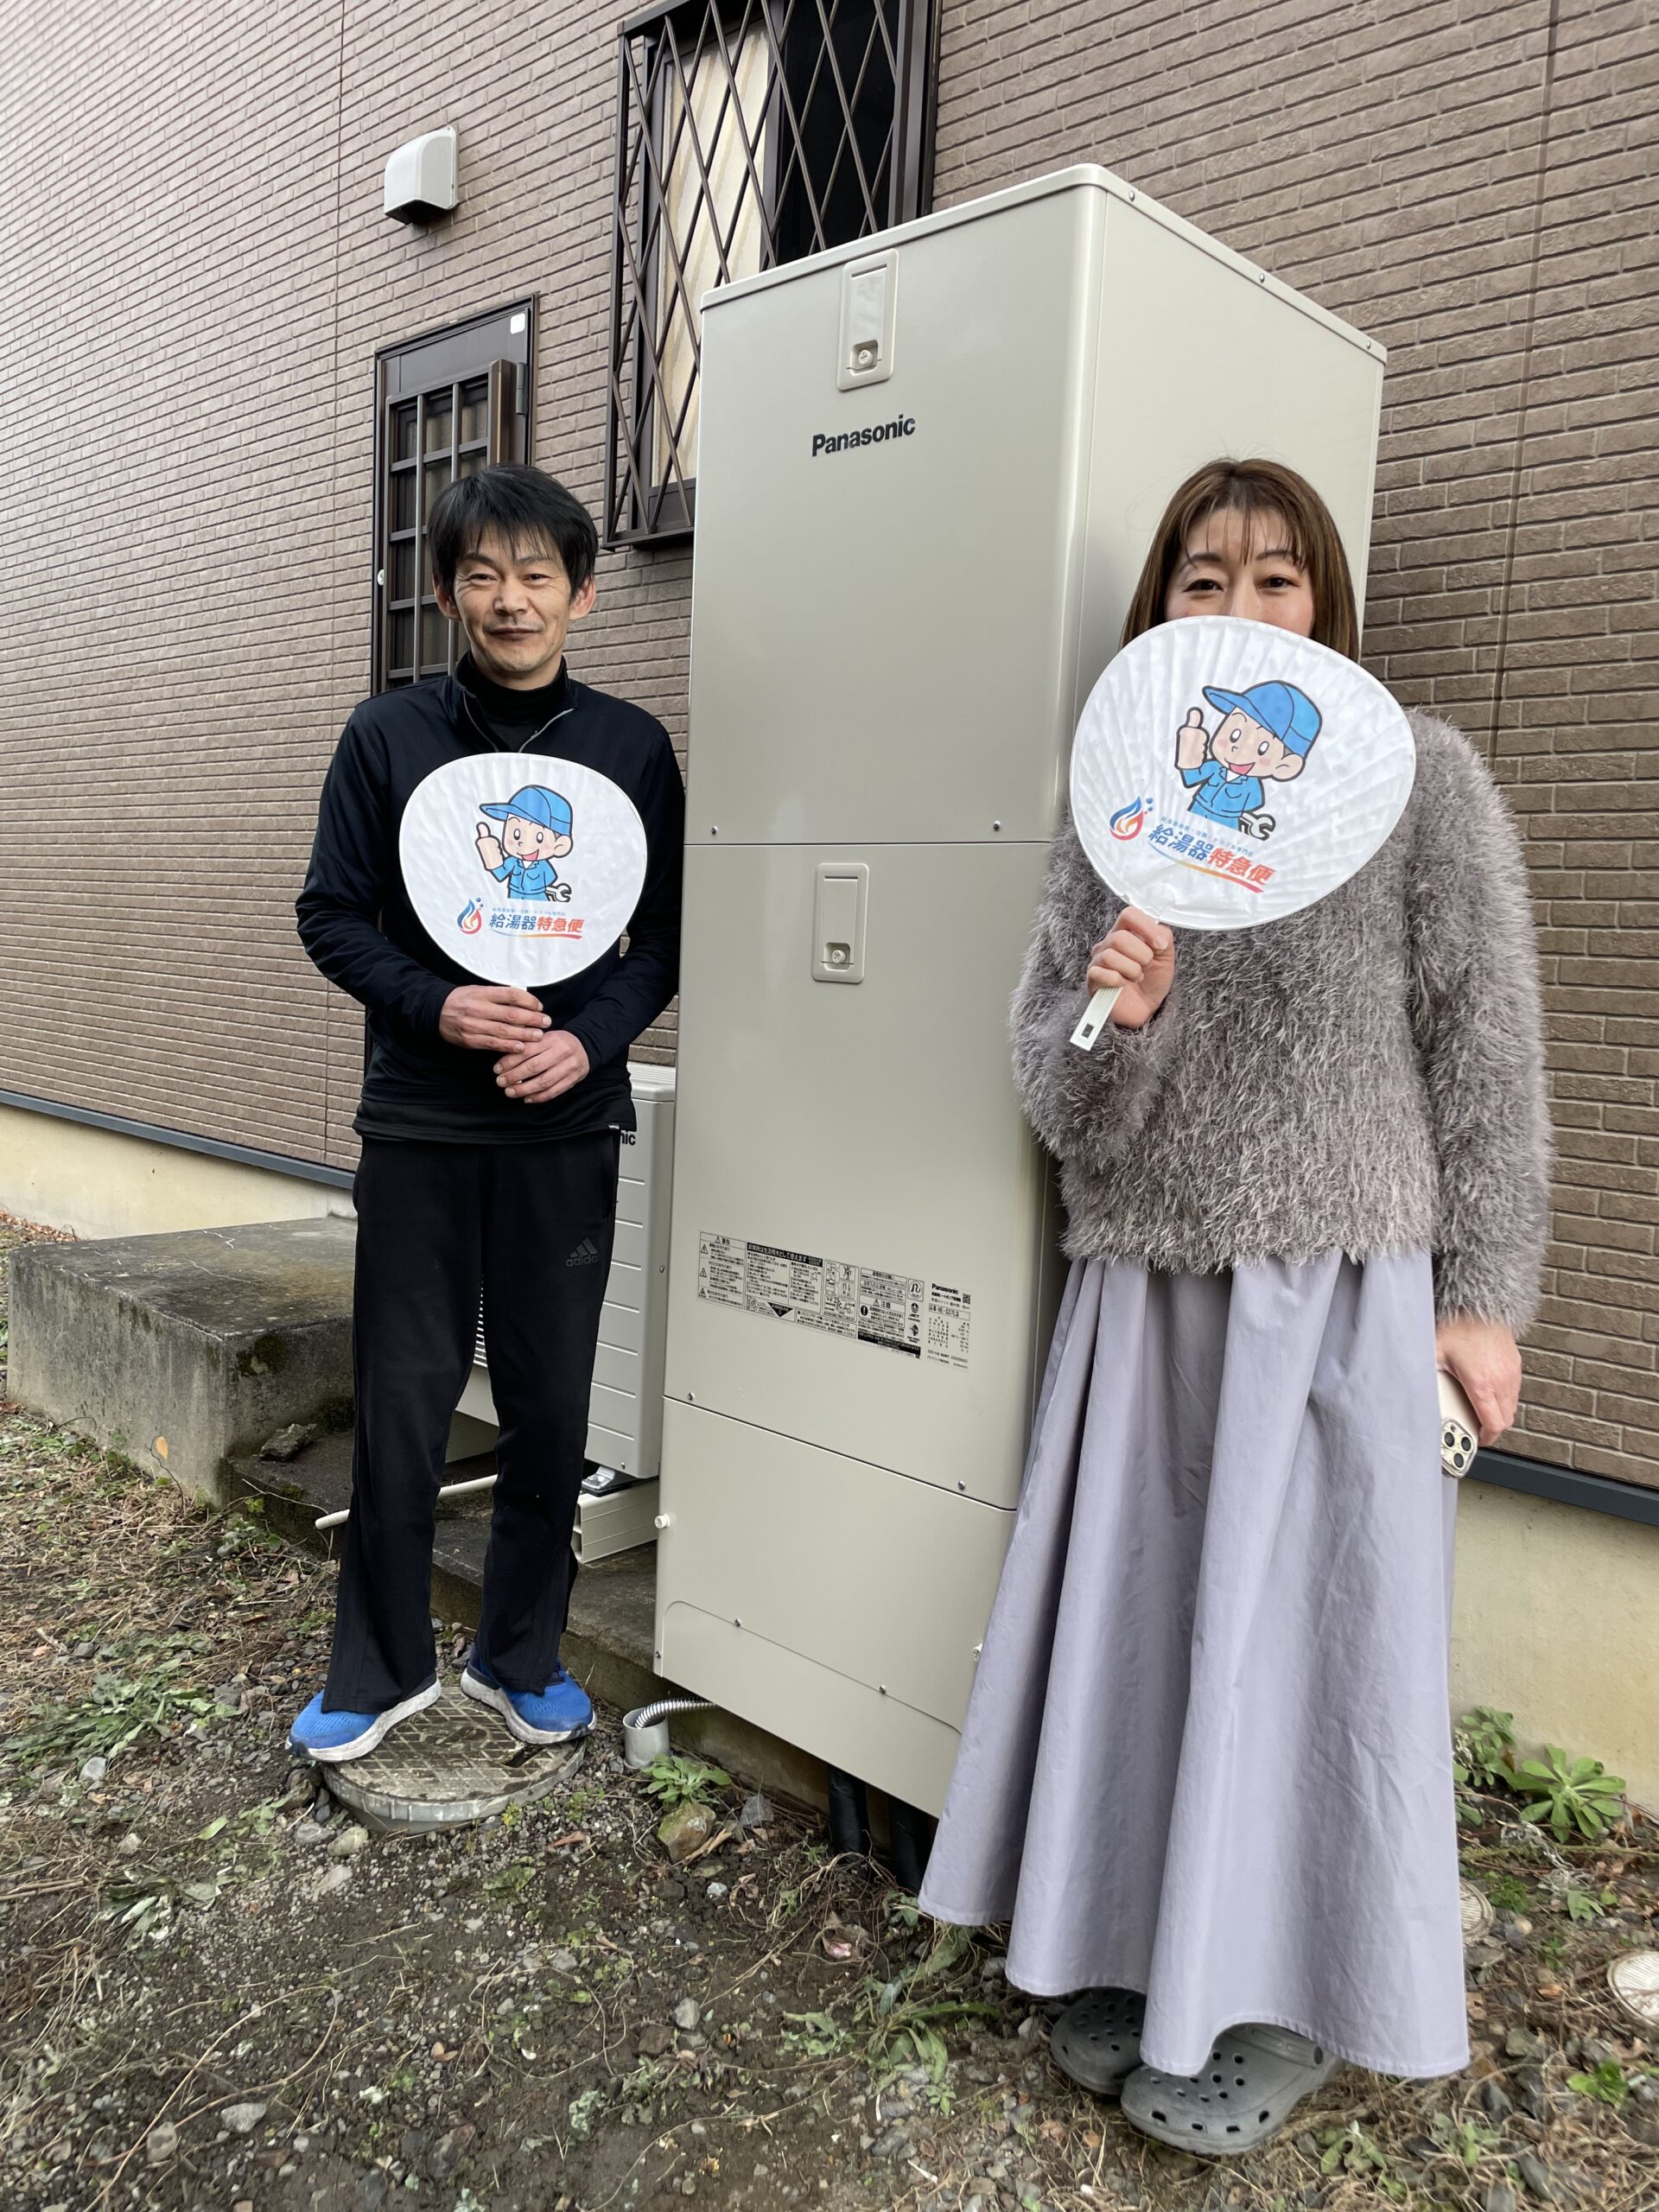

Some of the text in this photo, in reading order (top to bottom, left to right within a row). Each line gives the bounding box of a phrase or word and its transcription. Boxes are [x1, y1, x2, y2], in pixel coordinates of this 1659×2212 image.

[811, 414, 916, 457] Panasonic
[1147, 823, 1278, 886] 給湯器特急便
[489, 913, 585, 932] 給湯器特急便
[566, 1254, 601, 1267] adida
[932, 1283, 958, 1294] Panasonic
